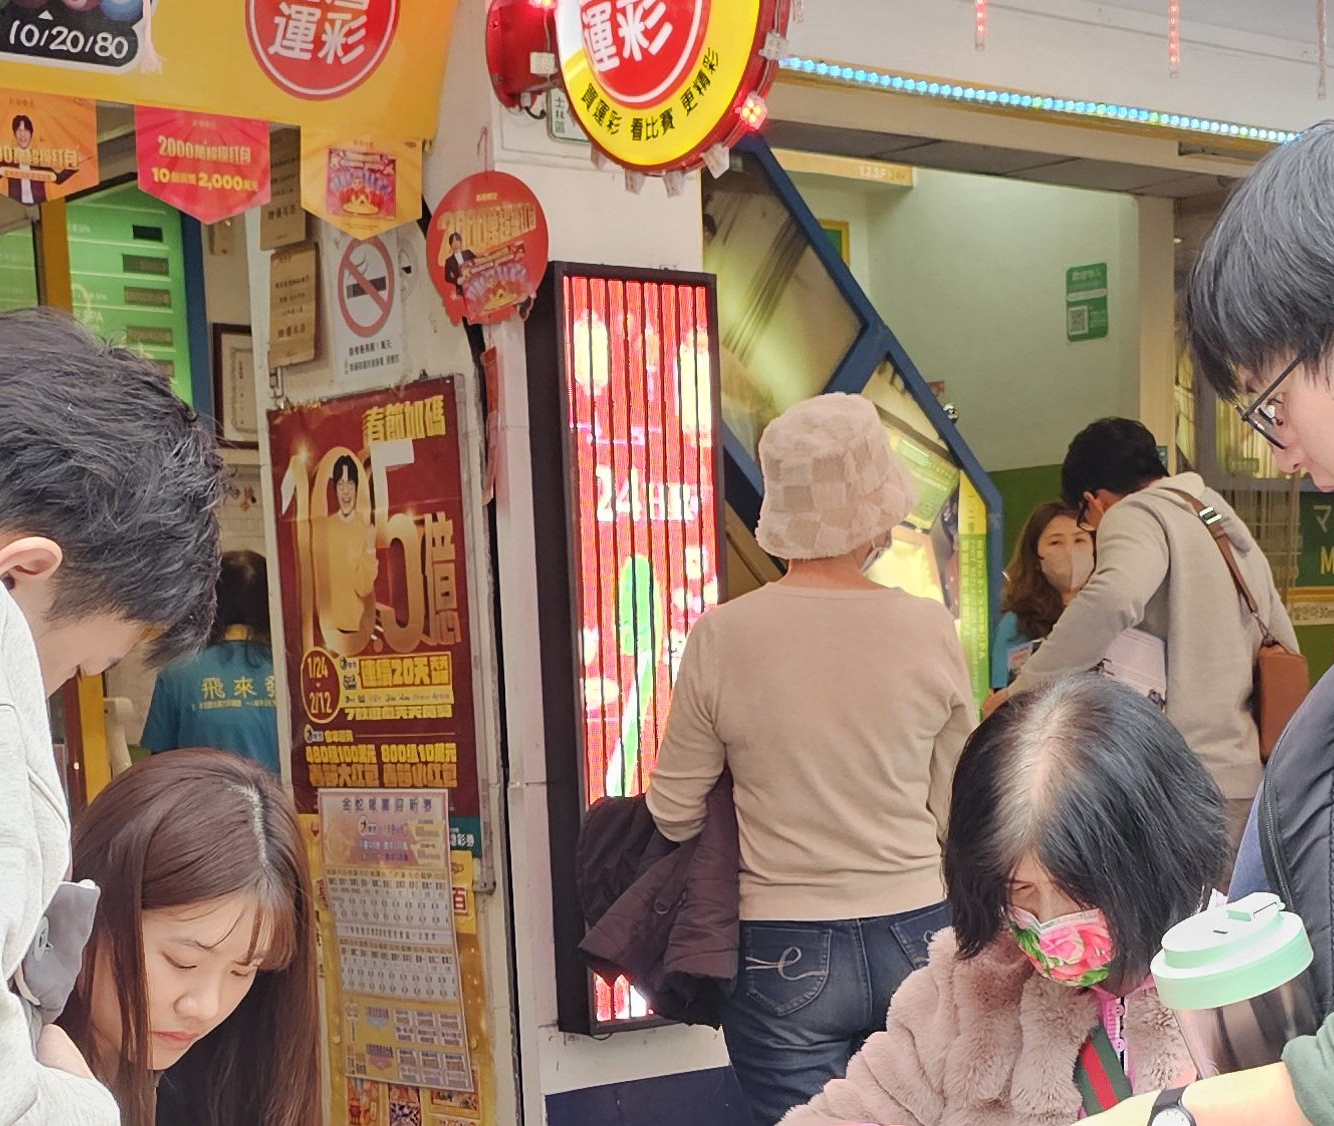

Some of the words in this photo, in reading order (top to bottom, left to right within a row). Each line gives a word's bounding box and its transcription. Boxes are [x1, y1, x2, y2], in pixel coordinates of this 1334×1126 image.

[10, 20, 129, 59] 10/20/80
[267, 2, 368, 65] 運彩
[582, 0, 673, 73] 運彩
[364, 394, 447, 442] 春節加碼
